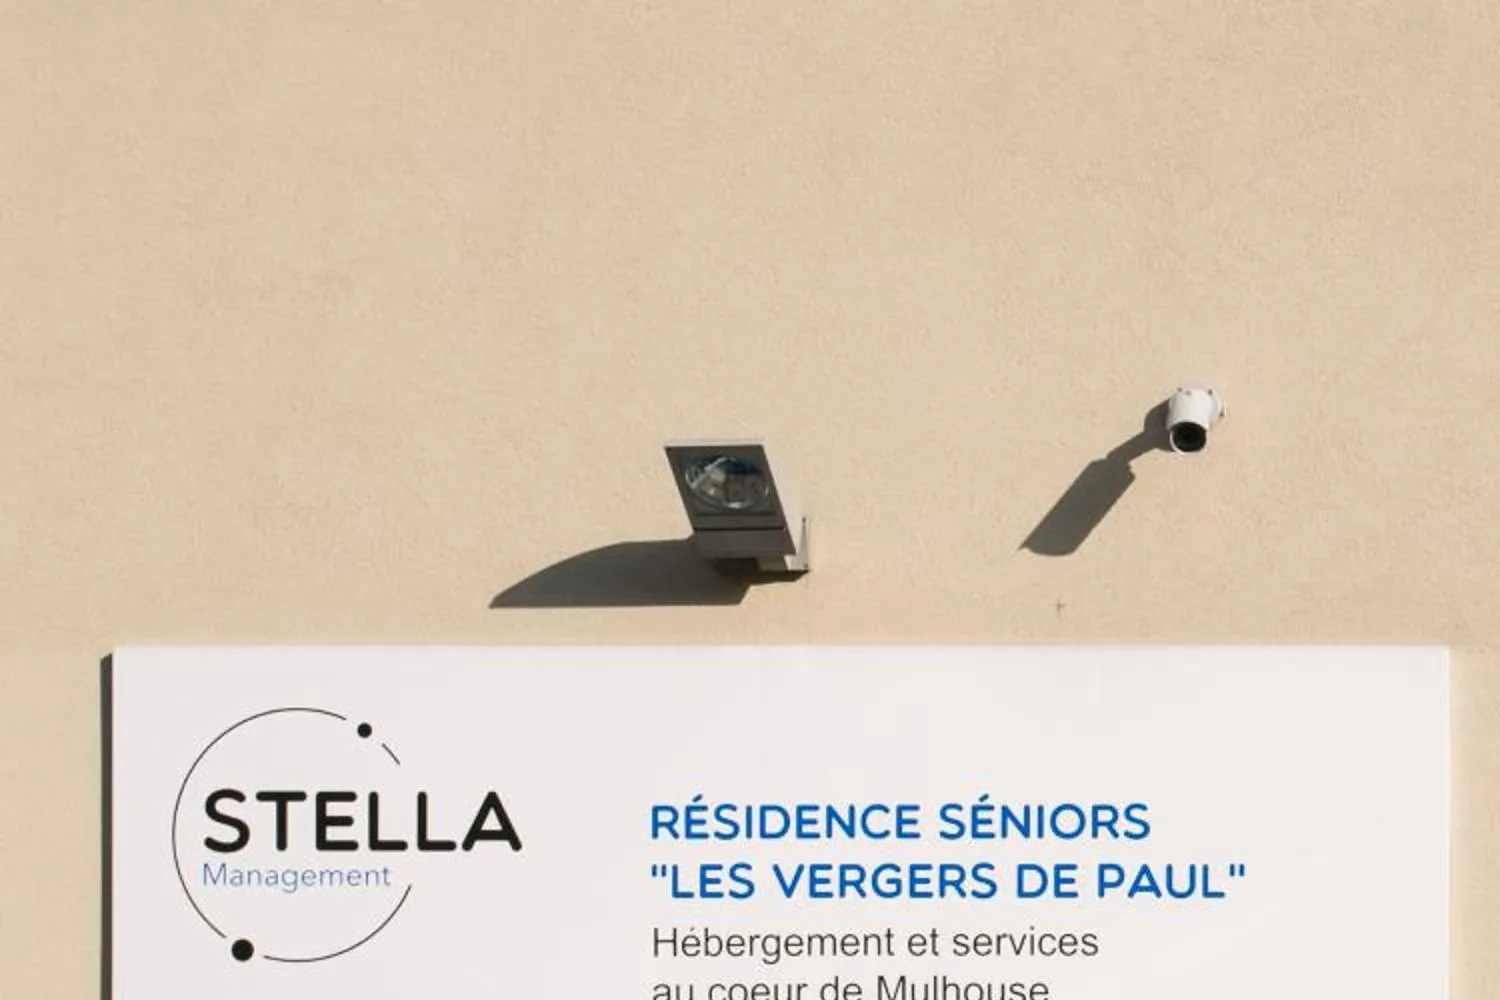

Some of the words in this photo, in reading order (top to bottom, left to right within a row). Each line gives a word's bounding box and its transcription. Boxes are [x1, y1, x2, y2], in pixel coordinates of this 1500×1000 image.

[203, 787, 523, 854] STELLA
[651, 793, 922, 841] RÉSIDENCE
[938, 793, 1151, 841] SÉNIORS
[203, 862, 390, 894] Management
[650, 861, 756, 901] "LES
[771, 861, 998, 900] VERGERS
[1015, 863, 1080, 899] DE
[1097, 862, 1246, 900] PAUL"
[653, 927, 895, 966] Hébergement
[907, 927, 940, 957] et
[952, 925, 1099, 957] services
